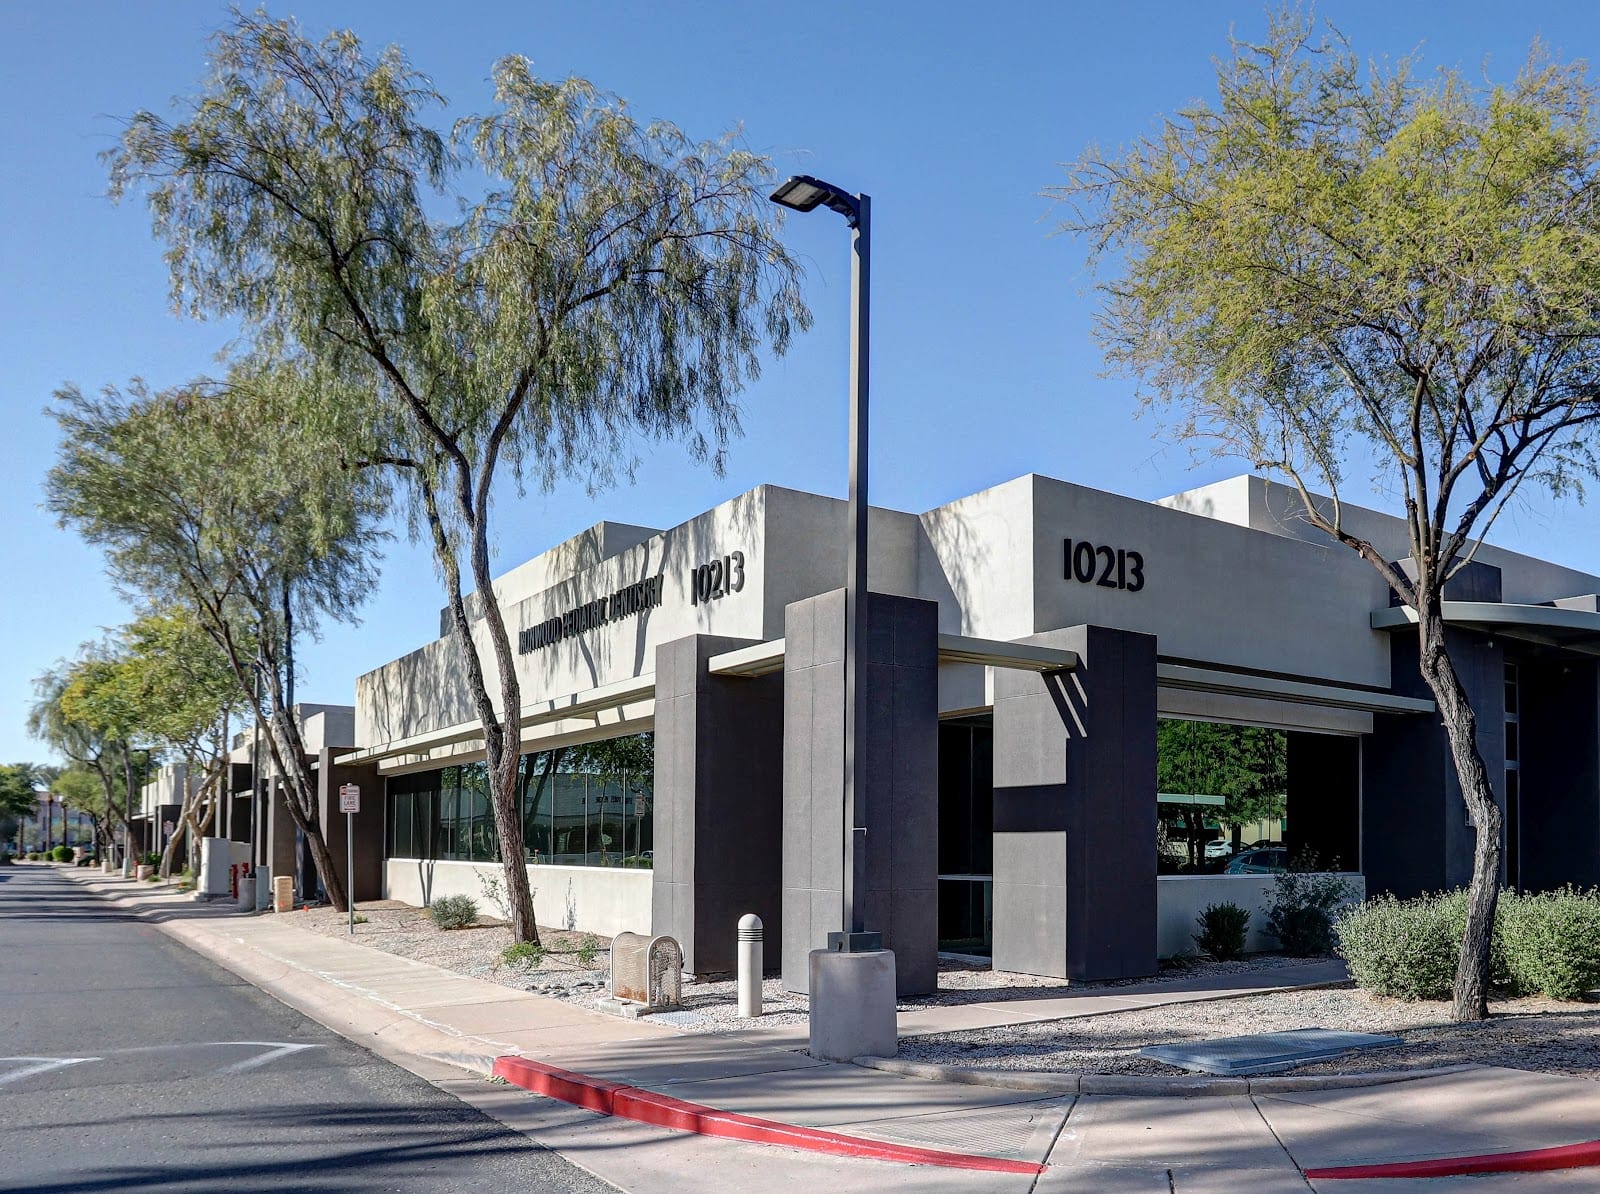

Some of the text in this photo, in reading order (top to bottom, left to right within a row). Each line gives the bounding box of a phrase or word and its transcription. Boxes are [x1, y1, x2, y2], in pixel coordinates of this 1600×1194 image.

[690, 550, 745, 608] 10213
[1063, 538, 1145, 593] 10213
[518, 573, 665, 655] IRONWOOD PEDIATRIC DENTISTRY
